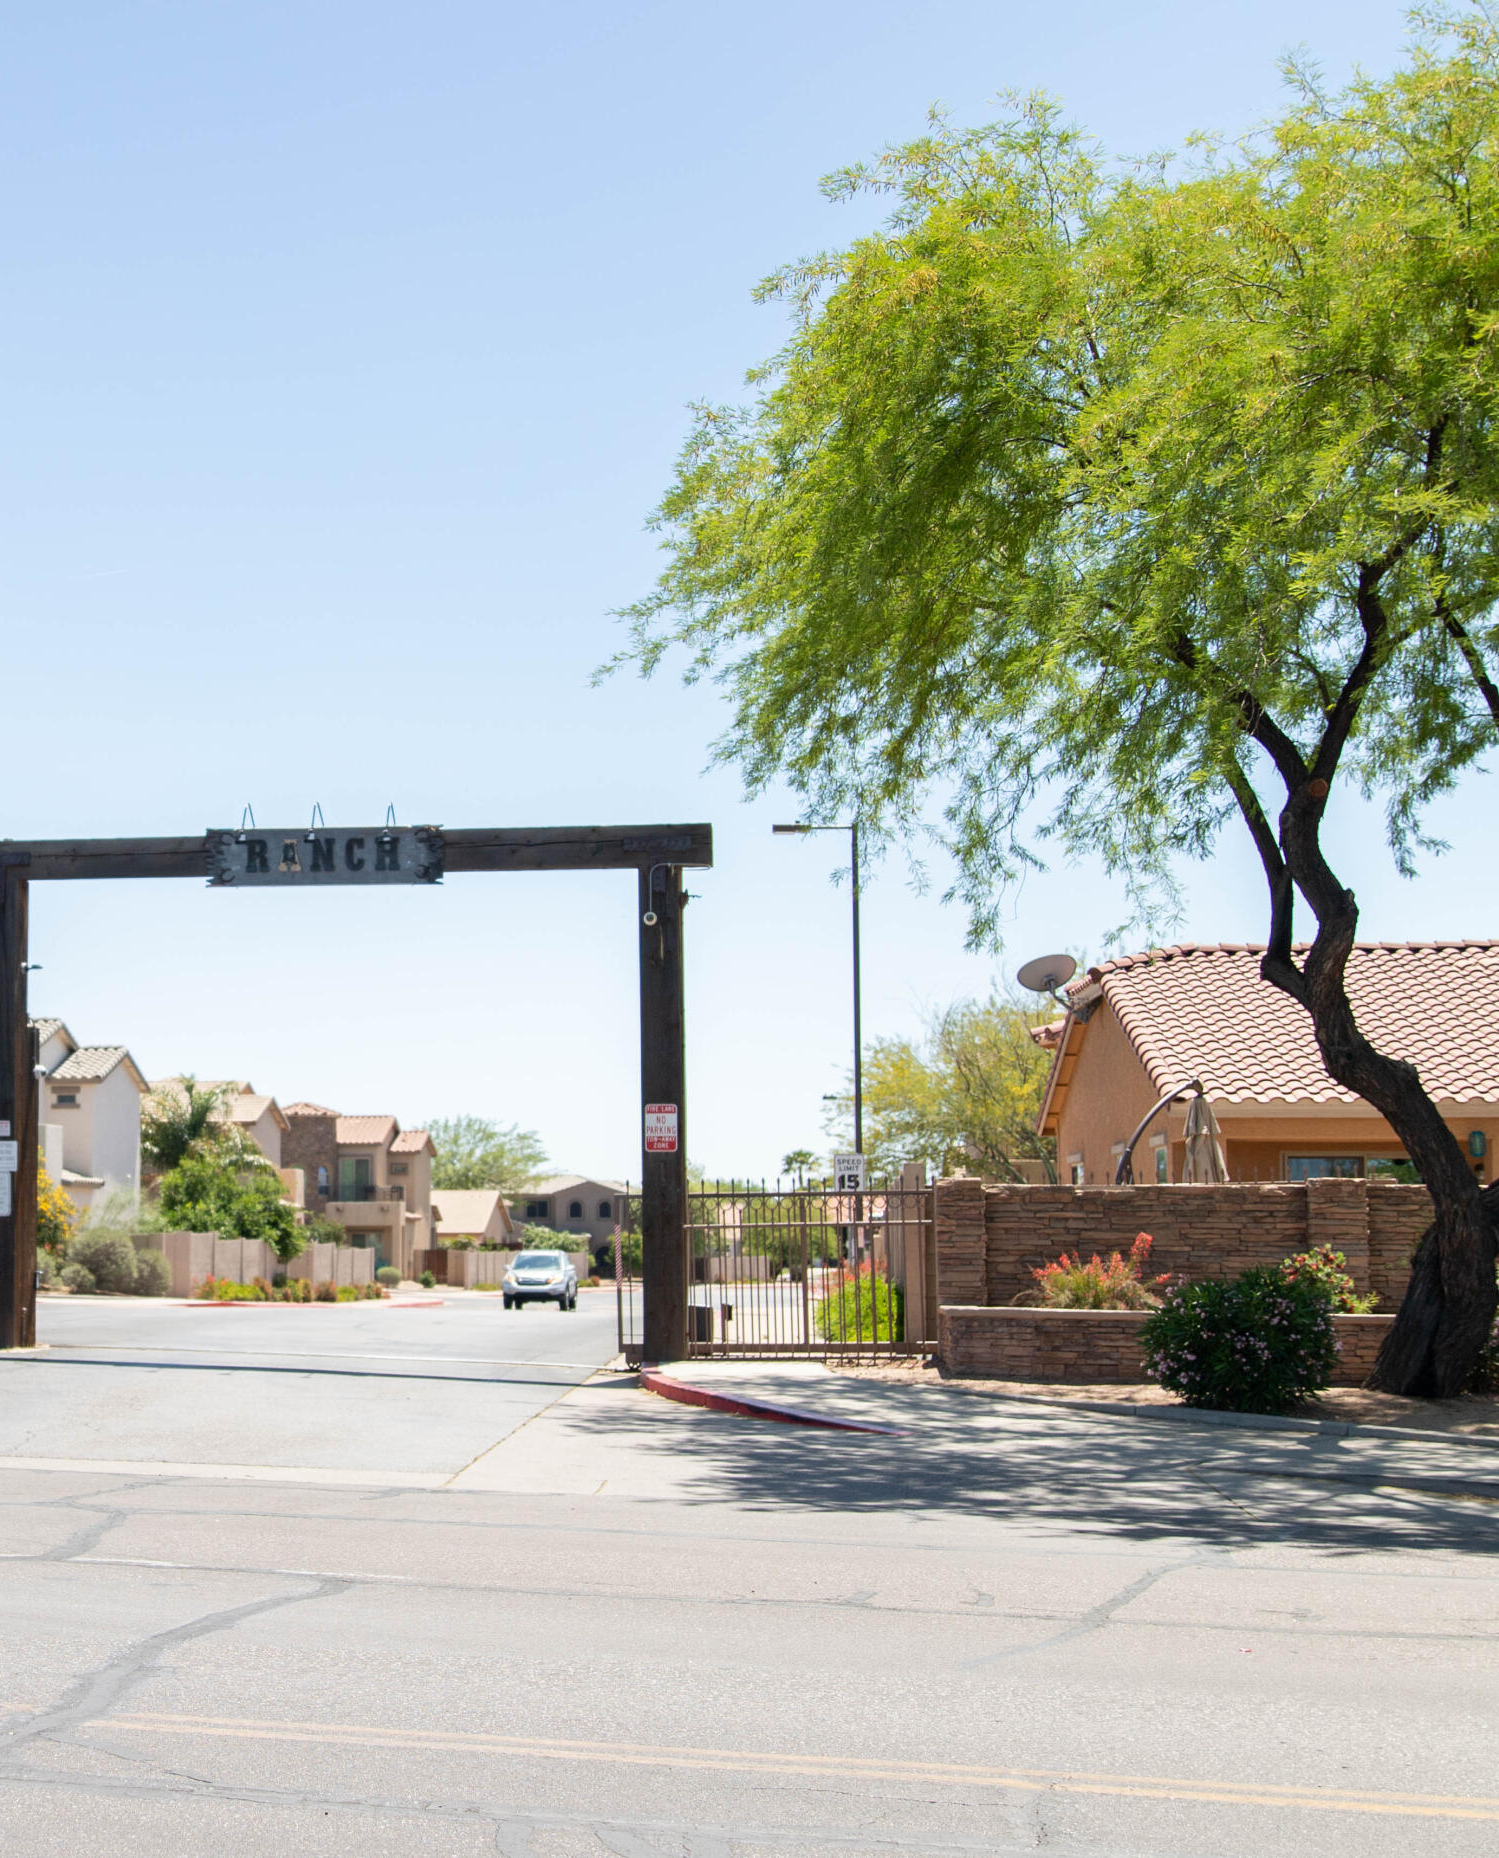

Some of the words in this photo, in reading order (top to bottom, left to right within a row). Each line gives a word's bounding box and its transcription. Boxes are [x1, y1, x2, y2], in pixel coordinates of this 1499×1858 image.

[245, 837, 400, 873] RANCH
[656, 1115, 666, 1124] NO
[646, 1126, 676, 1135] PARKING
[838, 1174, 860, 1189] 15
